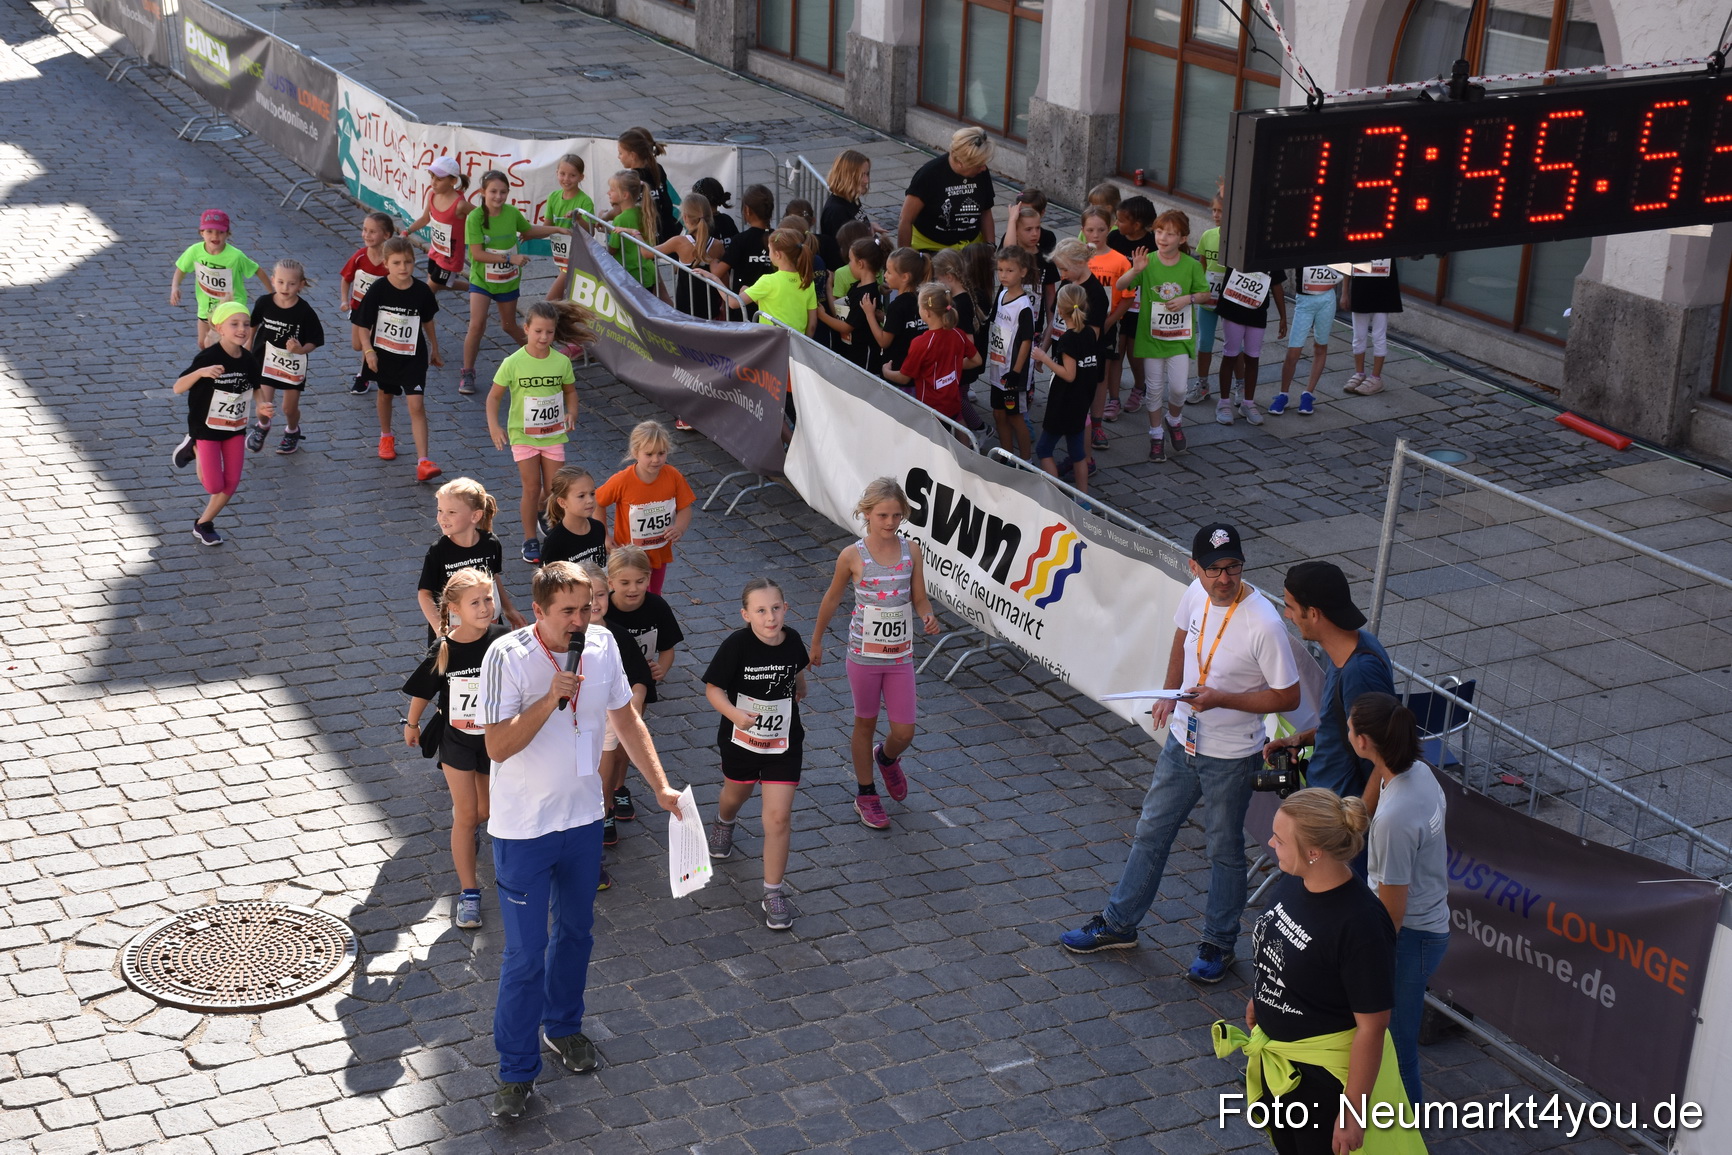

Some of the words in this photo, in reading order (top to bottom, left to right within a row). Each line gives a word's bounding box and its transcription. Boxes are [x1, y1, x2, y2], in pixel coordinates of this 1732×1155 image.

[297, 87, 331, 121] LOUNGE
[200, 271, 226, 288] 7106
[1235, 274, 1263, 295] 7582
[1158, 313, 1184, 325] 7091
[383, 322, 412, 338] 7510
[606, 329, 627, 344] smart
[271, 353, 300, 371] 7425
[678, 344, 736, 380] INDUSTRY
[736, 365, 782, 400] LOUNGE
[519, 376, 562, 388] BOCK
[671, 364, 764, 422] www.bockonline.de
[218, 401, 246, 416] 7433
[531, 405, 559, 421] 7405
[637, 513, 671, 532] 7455
[905, 467, 1021, 585] swn
[1083, 518, 1102, 536] Energie
[1107, 529, 1128, 547] Wasser
[1134, 541, 1153, 556] Netze
[445, 557, 483, 570] Neumarkter
[970, 580, 1044, 640] neumarkt
[872, 619, 906, 637] 7051
[744, 665, 785, 673] Neumarkter
[749, 737, 770, 747] Hanna
[1274, 902, 1312, 943] Neumarkter
[1275, 919, 1307, 951] STADTLAUF
[1547, 901, 1690, 995] LOUNGE
